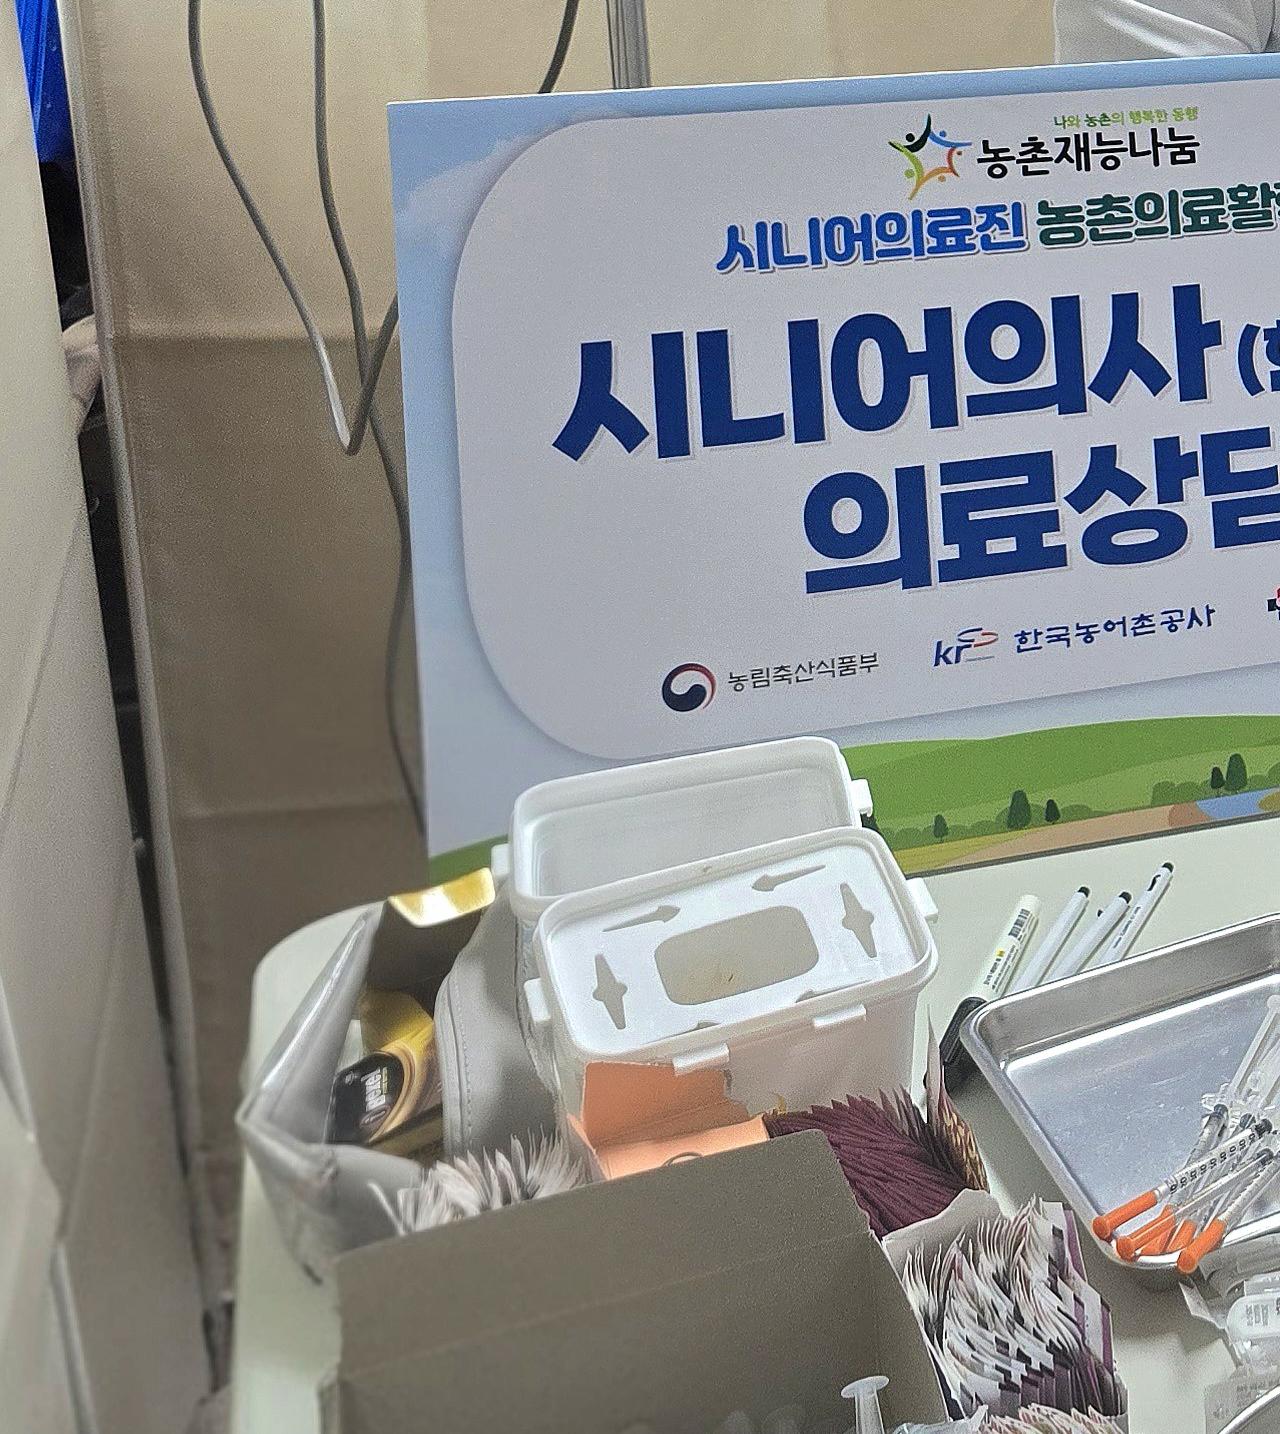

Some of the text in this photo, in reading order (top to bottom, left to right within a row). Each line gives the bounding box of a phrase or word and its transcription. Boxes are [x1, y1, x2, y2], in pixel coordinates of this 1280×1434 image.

[1054, 107, 1198, 129] 나와 농촌의 행복한 동행
[976, 126, 1200, 180] 농촌재능나눔
[716, 201, 1028, 273] 시니어의료진
[552, 284, 1222, 461] 시니어의사
[1013, 604, 1216, 654] 한국농어촌공사
[728, 653, 880, 693] 농림축산식품부
